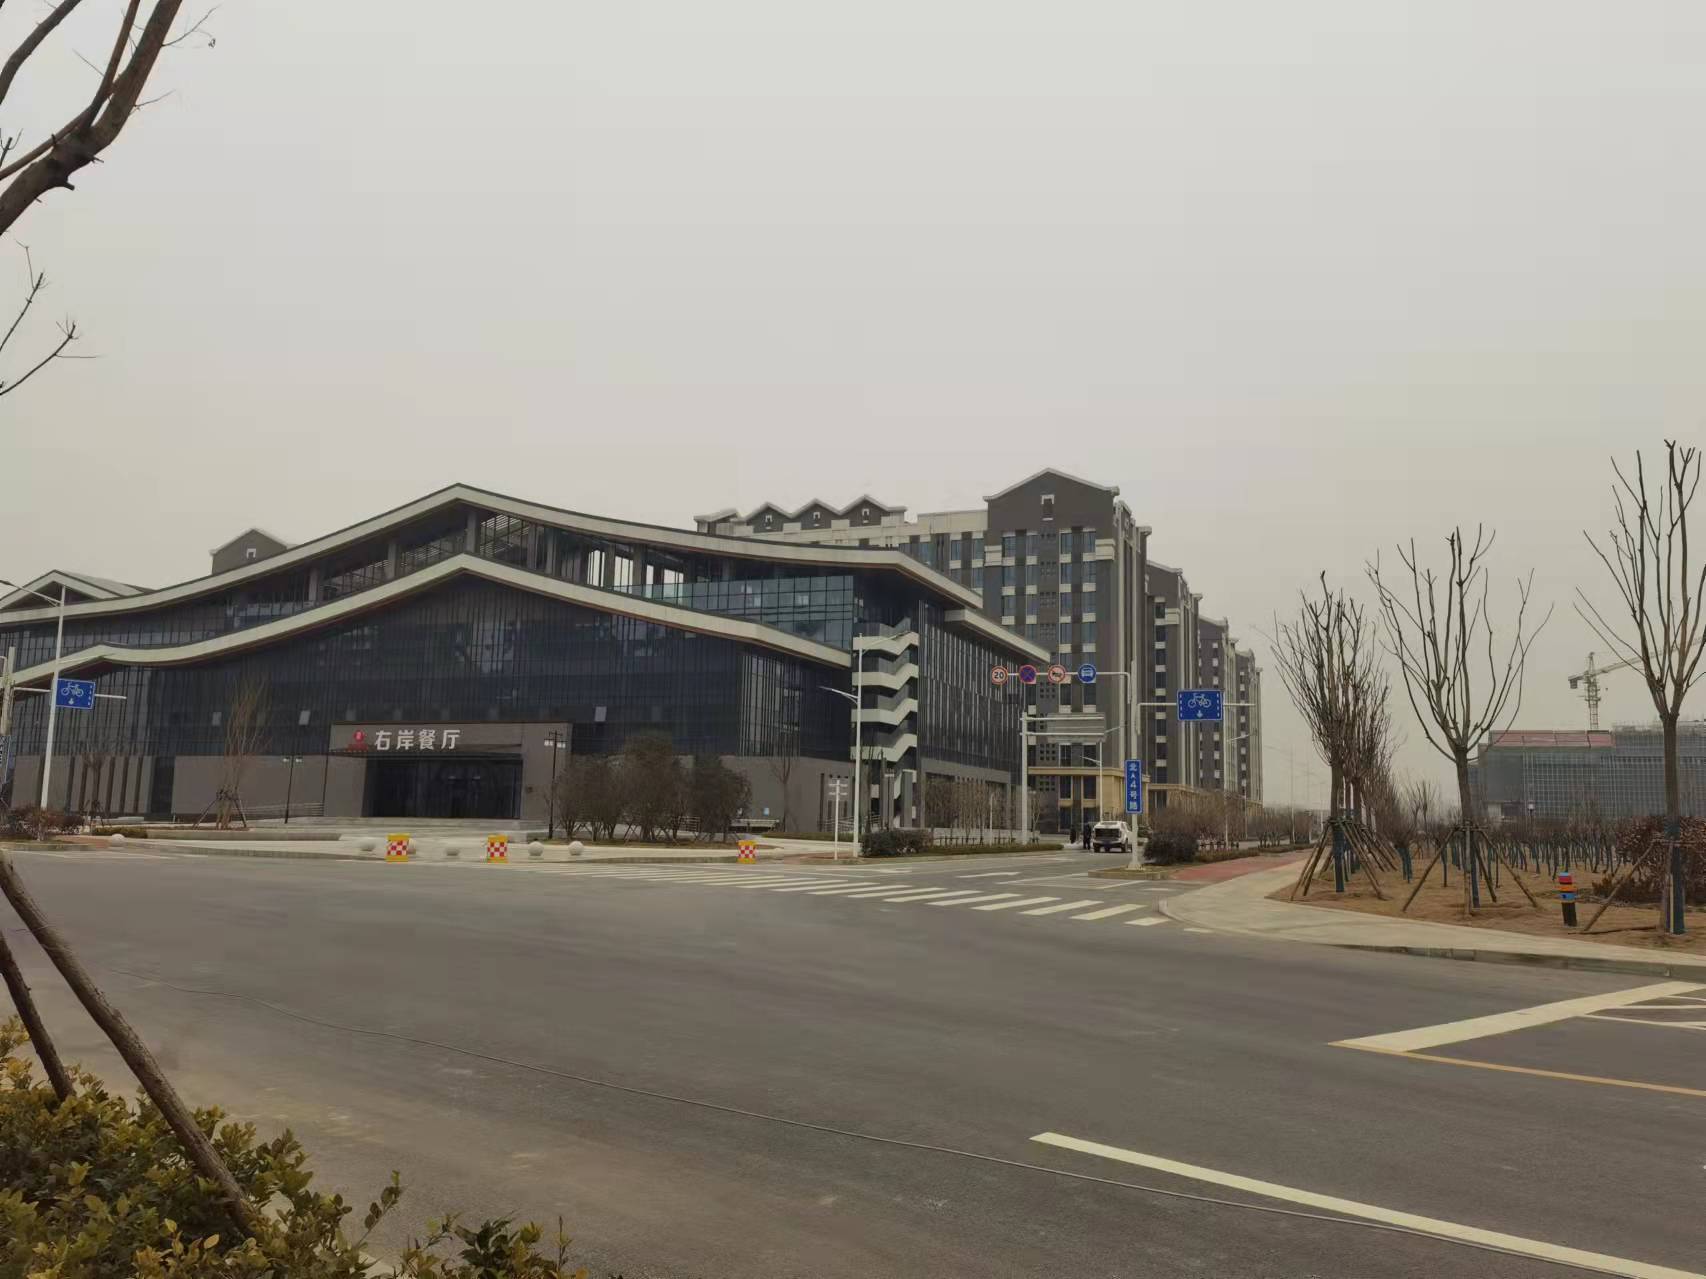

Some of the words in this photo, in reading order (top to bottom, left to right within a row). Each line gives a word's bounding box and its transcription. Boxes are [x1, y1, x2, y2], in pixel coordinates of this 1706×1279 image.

[994, 671, 1004, 679] 20
[374, 728, 461, 751] 右岸餐厅
